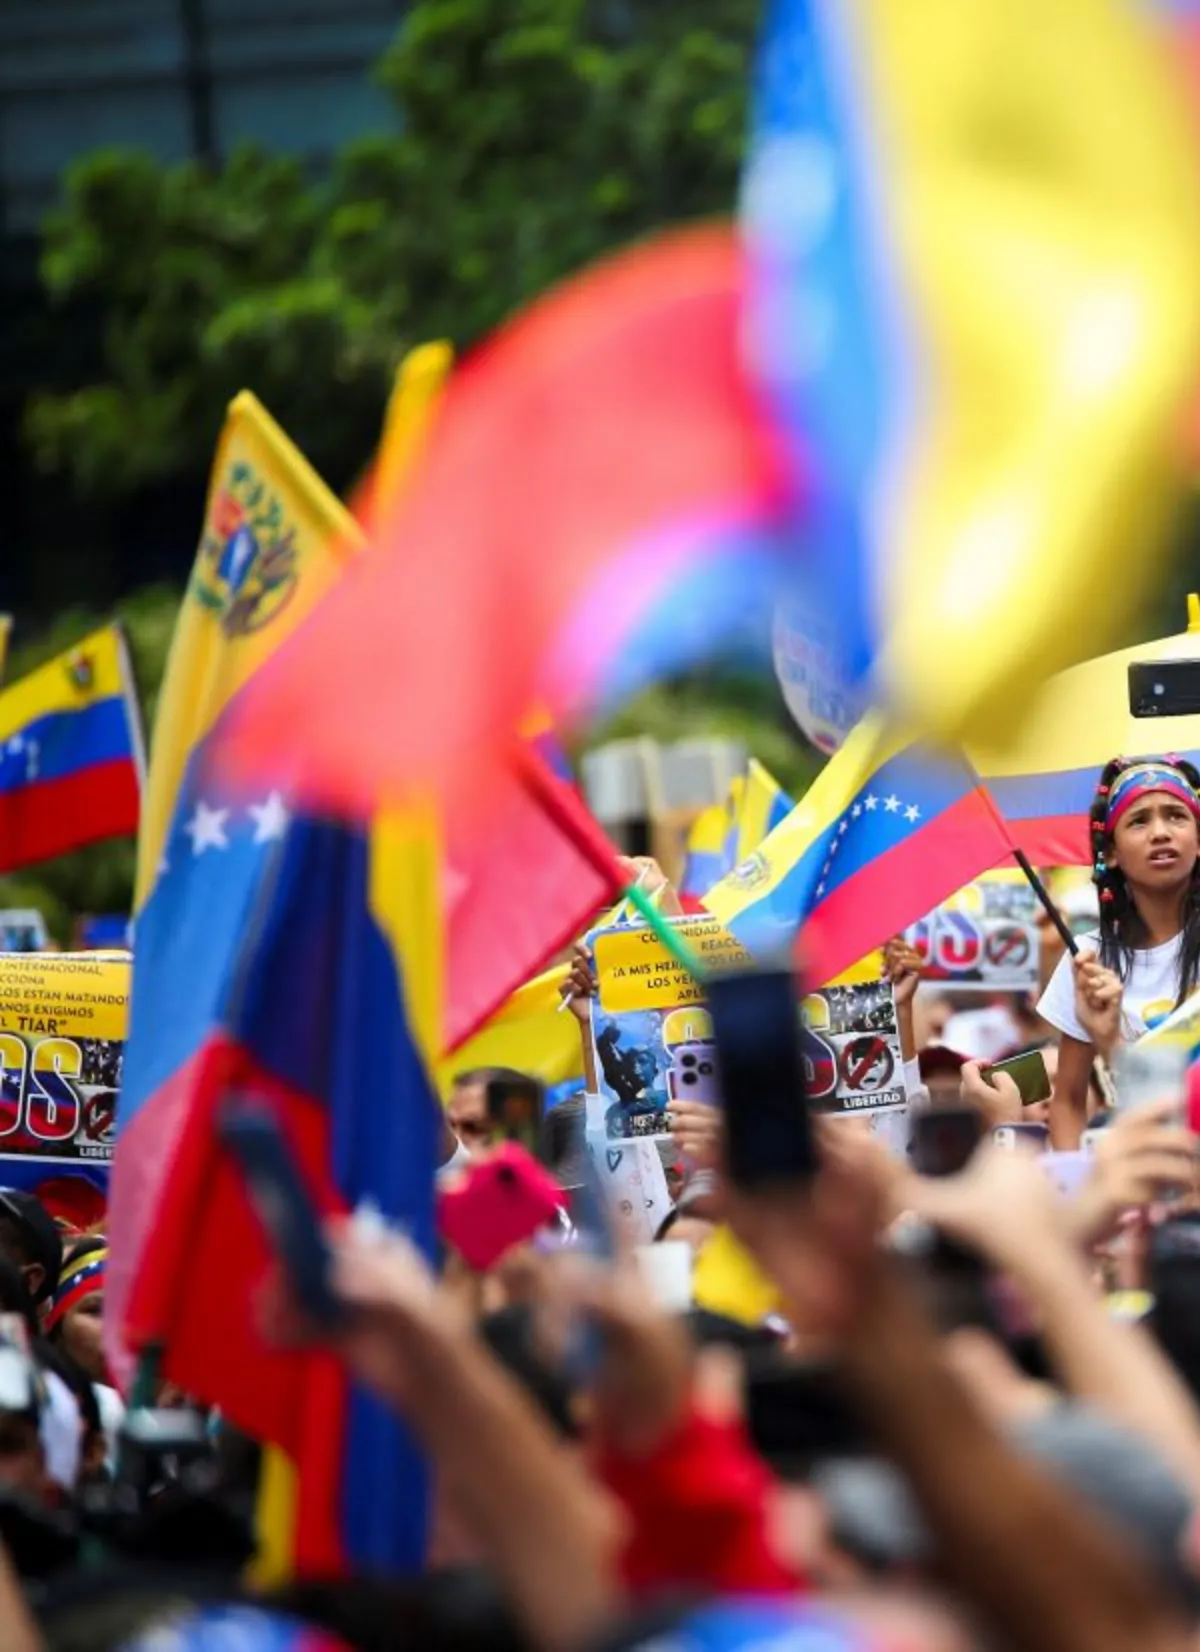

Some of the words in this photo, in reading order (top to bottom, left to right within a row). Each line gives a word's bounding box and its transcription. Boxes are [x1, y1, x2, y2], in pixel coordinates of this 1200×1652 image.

[629, 964, 651, 976] MIS
[647, 976, 671, 989] LOS
[33, 1004, 95, 1018] EXIGIMOS
[843, 1091, 902, 1109] LIBERTAD
